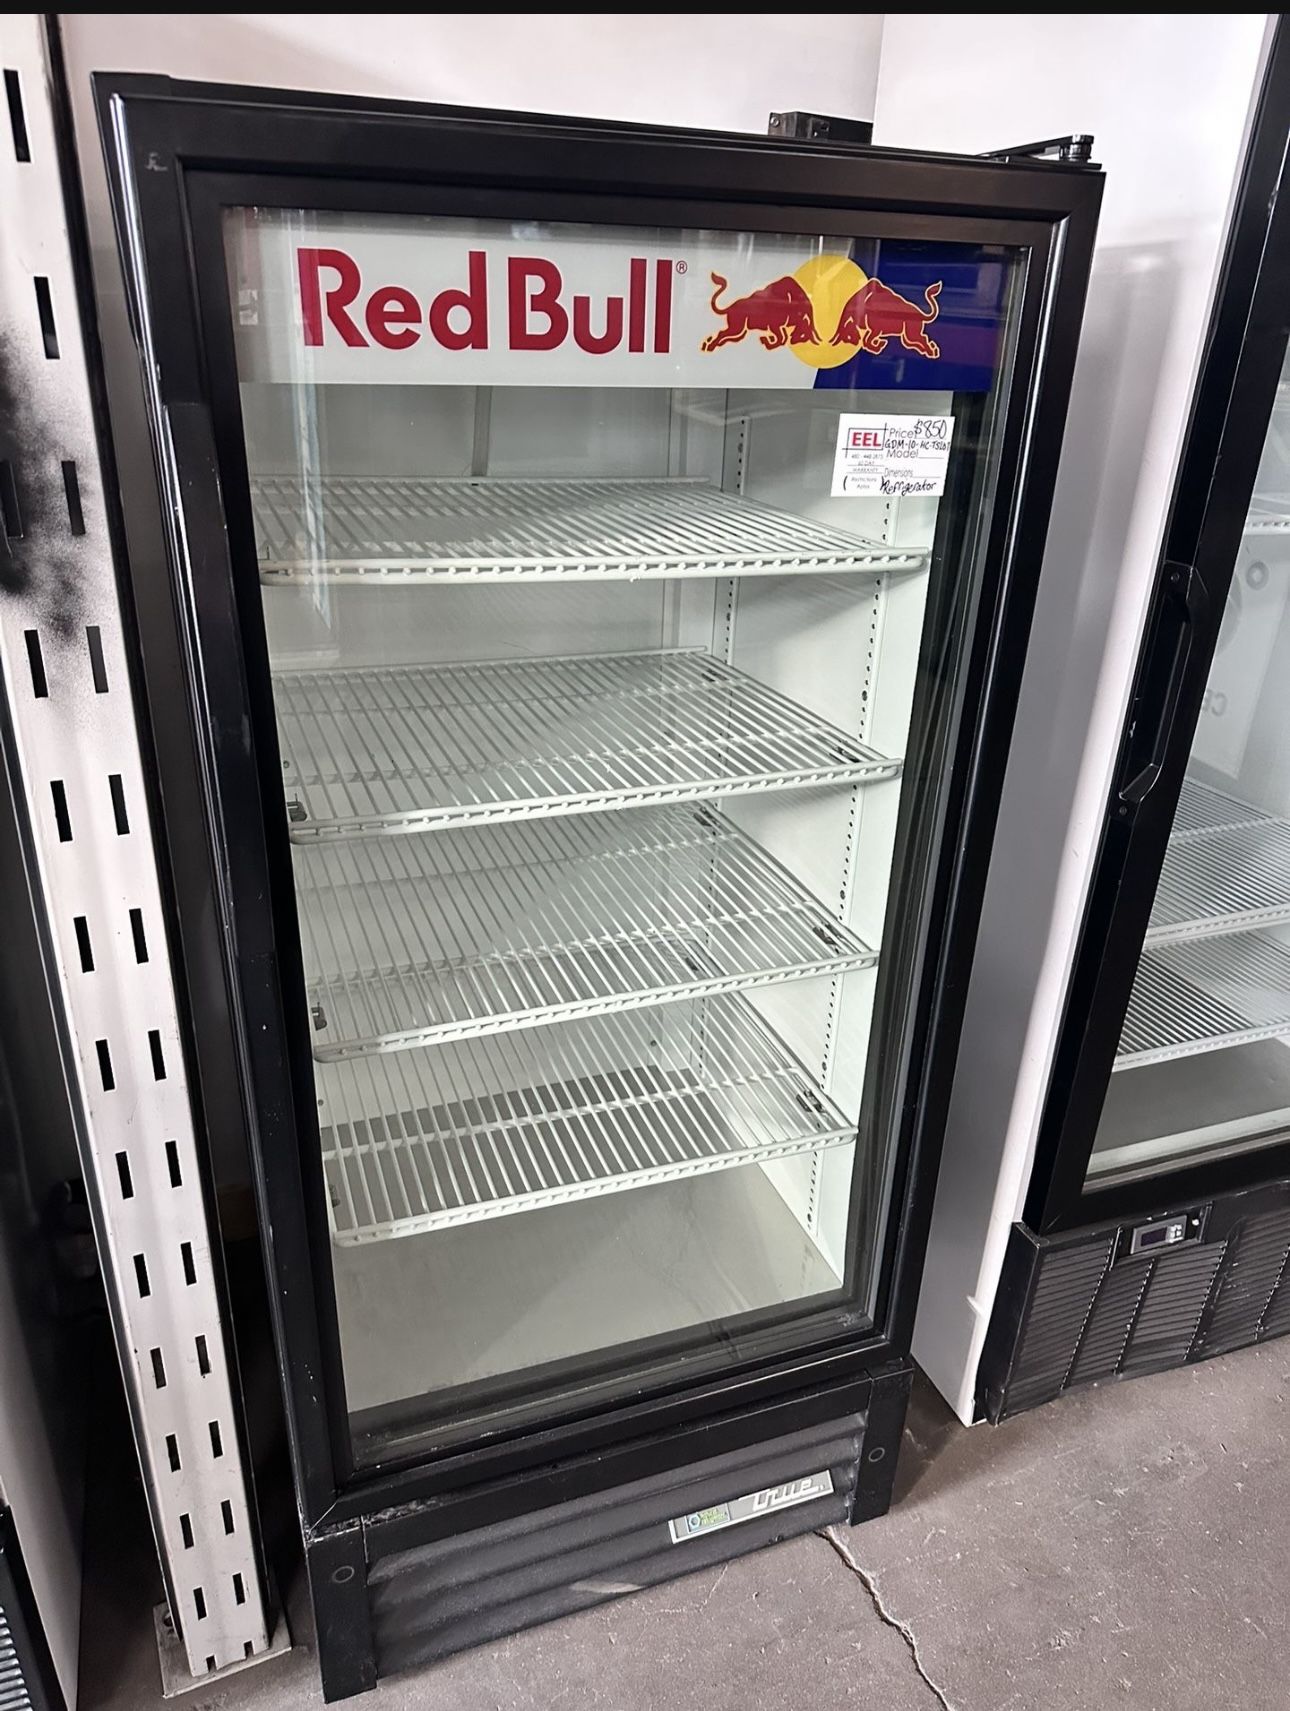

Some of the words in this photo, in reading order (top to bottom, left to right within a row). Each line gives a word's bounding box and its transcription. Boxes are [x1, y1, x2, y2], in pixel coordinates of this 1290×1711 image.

[297, 248, 488, 351] Red
[914, 418, 947, 439] $850
[852, 432, 882, 447] EEL
[886, 449, 919, 458] Model
